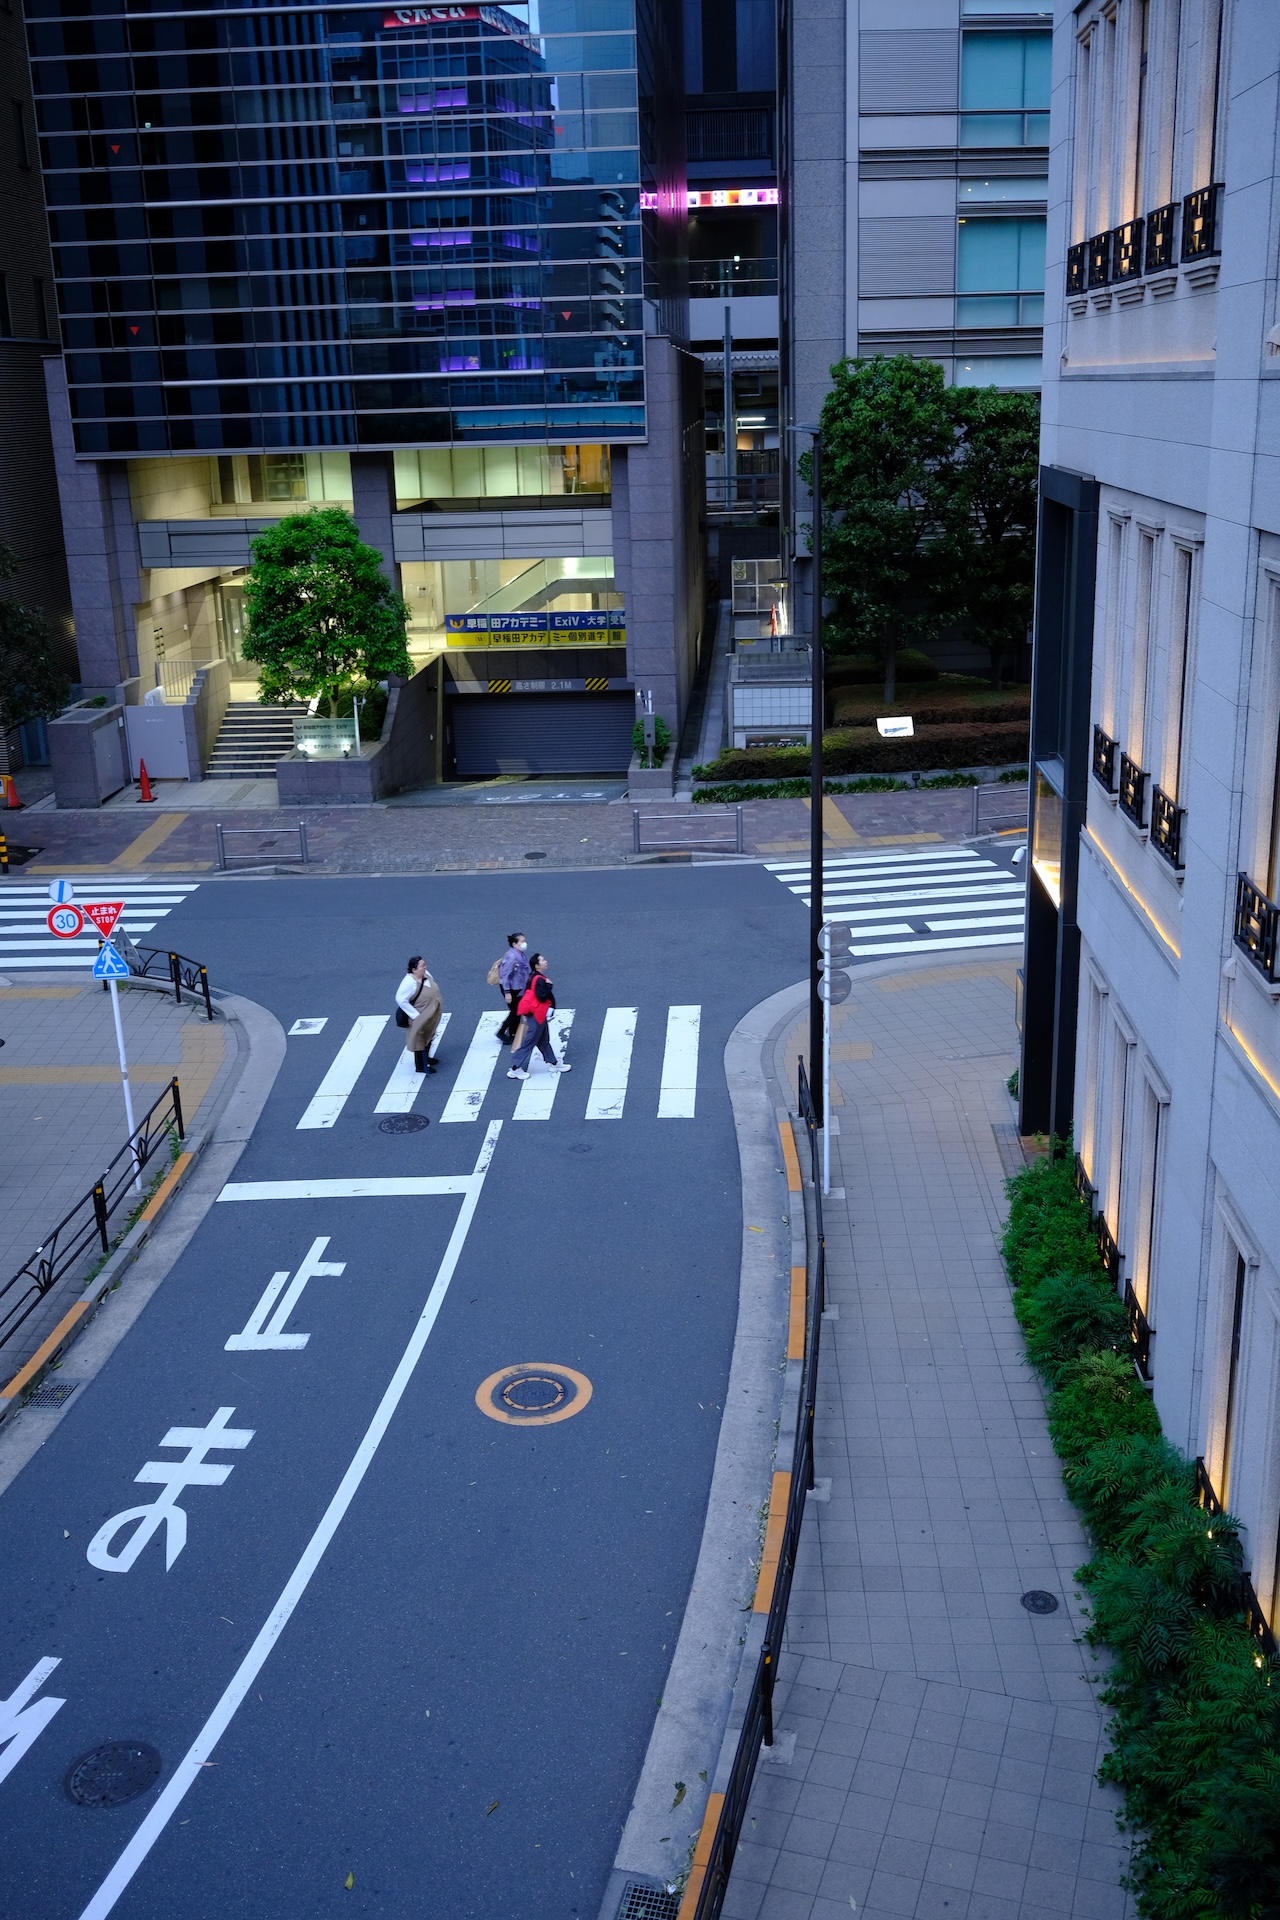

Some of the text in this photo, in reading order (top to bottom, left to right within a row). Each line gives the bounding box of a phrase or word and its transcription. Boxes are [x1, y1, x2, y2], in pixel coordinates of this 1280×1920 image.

[467, 618, 546, 628] 早稲田アカデミー
[516, 681, 572, 690] 高さ制限 2.1M
[91, 906, 118, 916] 止まれ
[56, 914, 76, 929] 30
